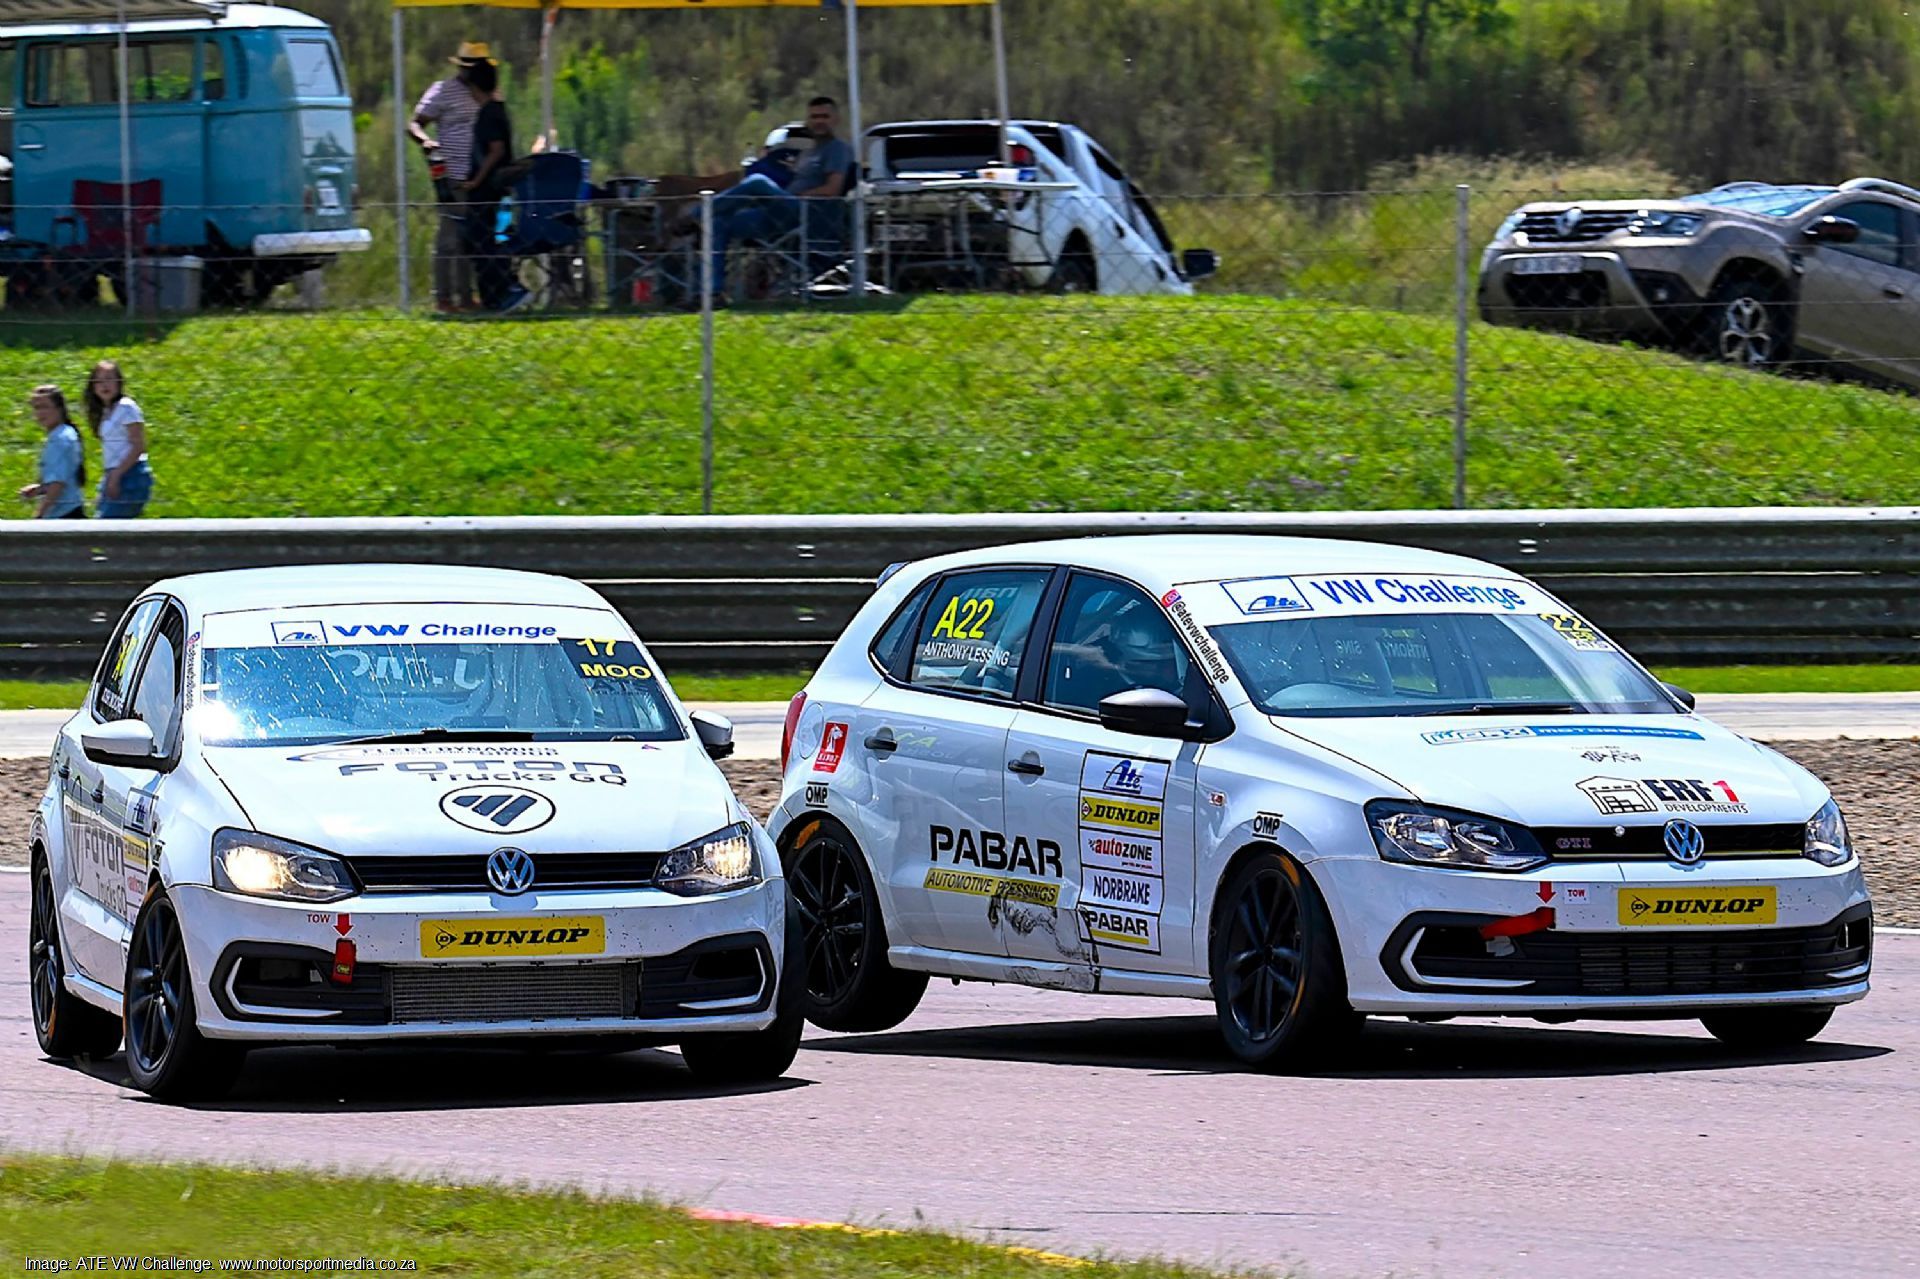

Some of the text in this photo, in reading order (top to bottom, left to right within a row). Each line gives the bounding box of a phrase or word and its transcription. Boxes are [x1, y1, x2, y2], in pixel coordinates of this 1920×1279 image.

[1310, 578, 1526, 610] VW Challenge
[931, 596, 995, 639] A22
[1539, 613, 1593, 632] 22
[332, 623, 557, 639] VW Challenge
[576, 638, 616, 656] 17
[923, 641, 971, 661] ANTHONY
[1171, 600, 1230, 684] @atevwchallenge
[580, 663, 652, 679] MOO
[418, 771, 556, 782] Trucks
[806, 786, 829, 804] OMP
[1641, 779, 1714, 802] ERF
[1094, 804, 1160, 825] DUNLOP
[1664, 802, 1749, 814] DEVELOPMENTS
[1253, 815, 1281, 835] OMP
[929, 823, 1063, 878] PABAR
[1556, 837, 1592, 849] GTI
[927, 871, 993, 893] AUTOMOTIVE
[1093, 875, 1150, 906] NORBRAKE
[1567, 889, 1586, 898] TOW
[1653, 898, 1765, 914] DUNLOP
[307, 914, 330, 924] TOW
[1086, 911, 1150, 937] PABAR
[459, 928, 590, 946] DUNLOP
